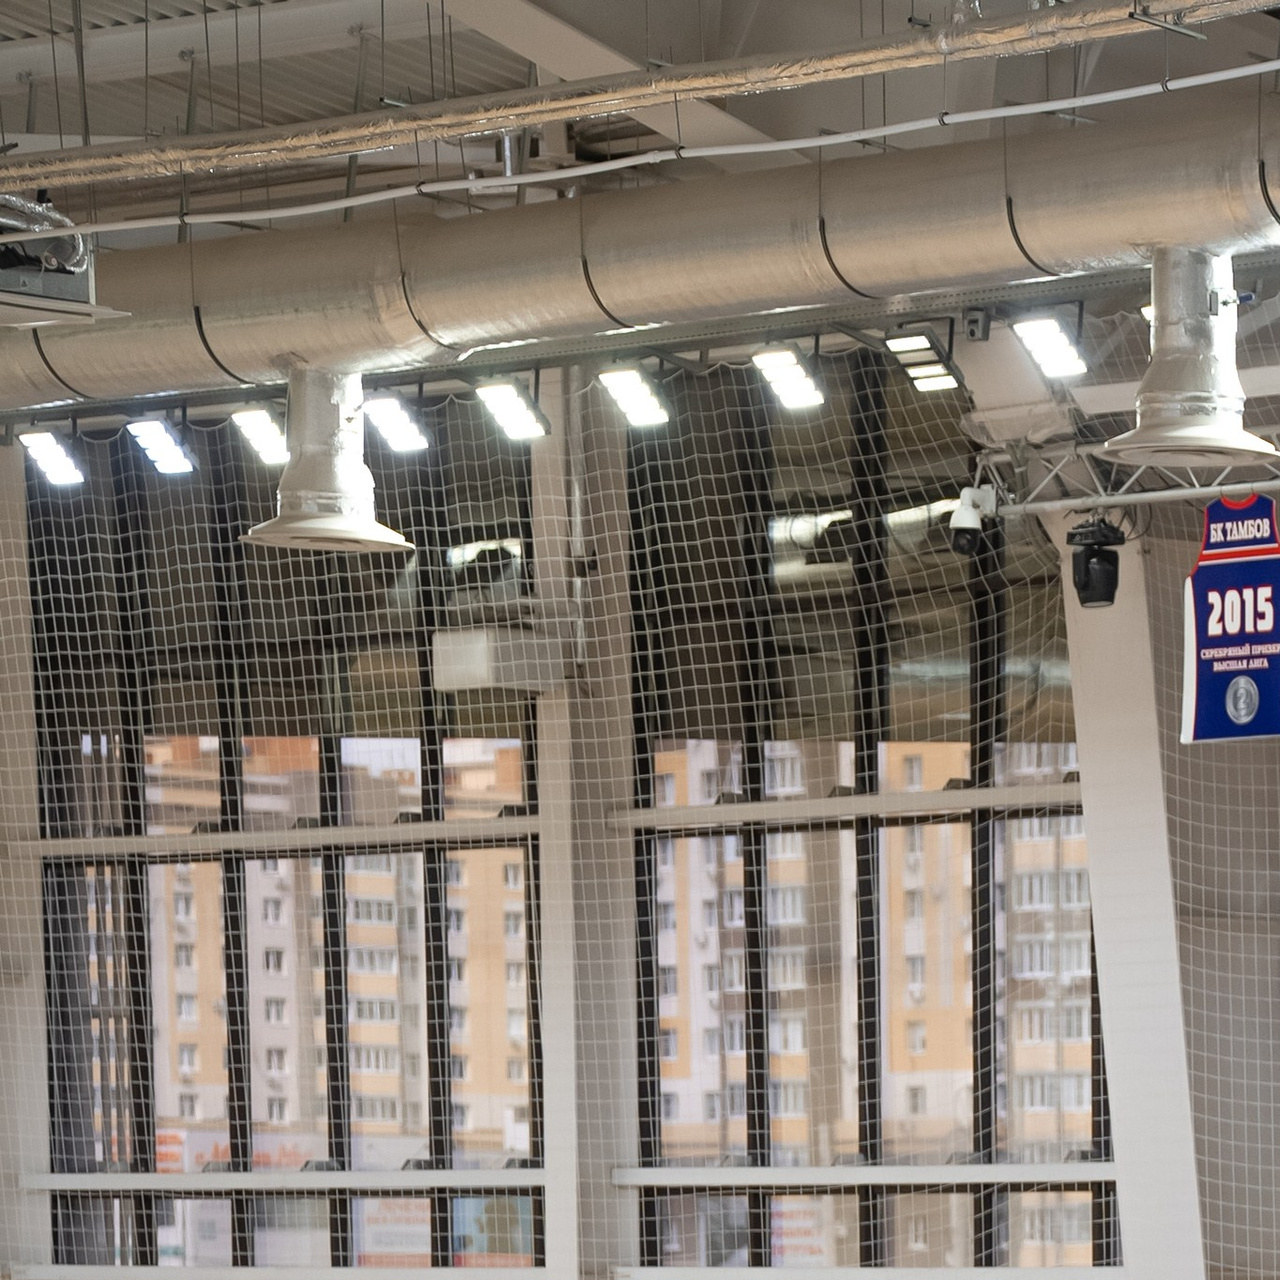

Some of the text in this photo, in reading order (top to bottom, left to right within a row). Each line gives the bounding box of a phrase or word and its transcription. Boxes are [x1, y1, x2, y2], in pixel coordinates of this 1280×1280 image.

[1210, 518, 1270, 543] БК ТАМБОВ
[1207, 585, 1275, 637] 2015
[1200, 643, 1250, 660] СЕРЕБРЯНЫЙ
